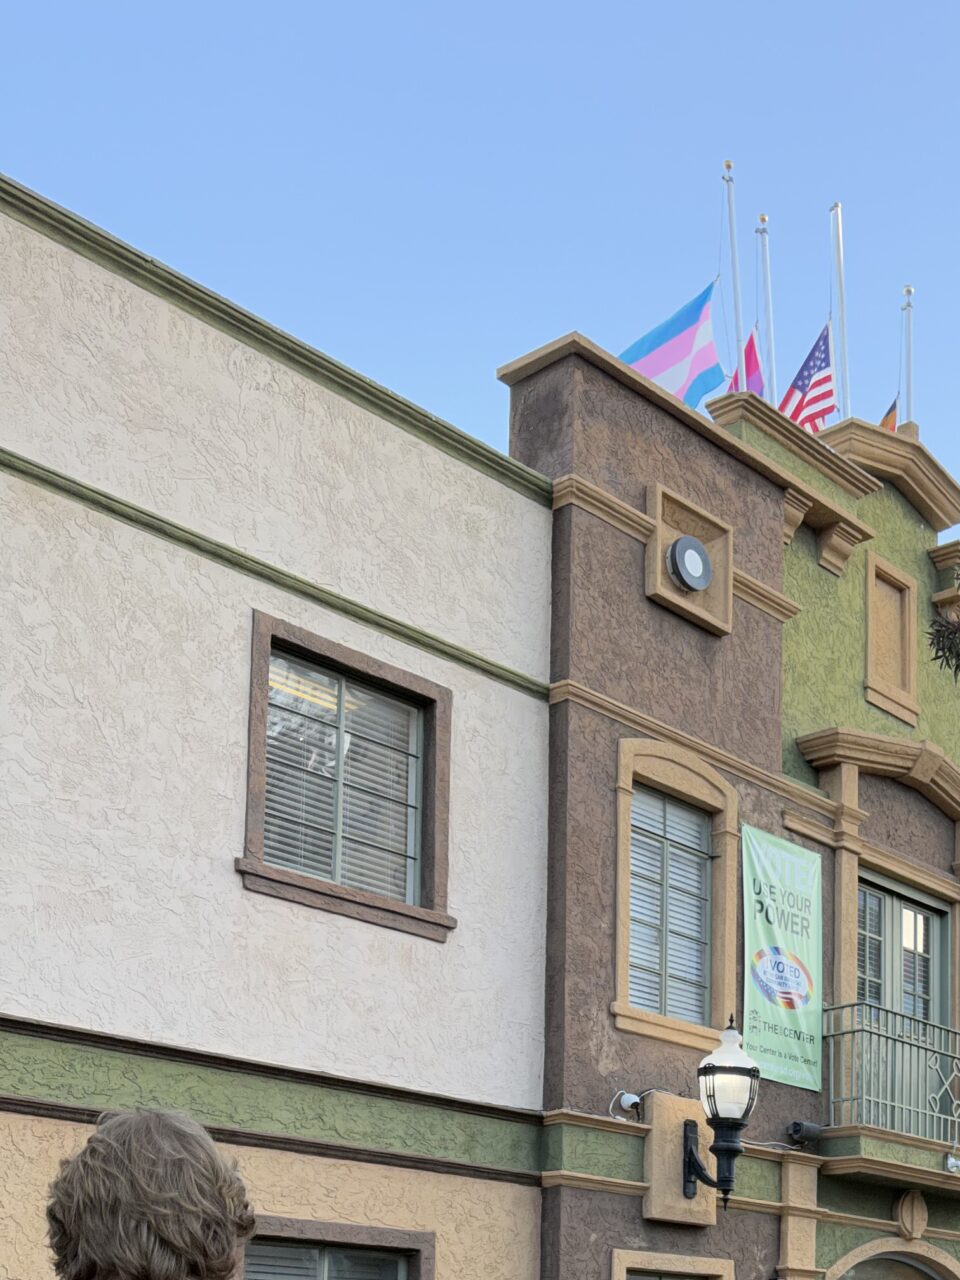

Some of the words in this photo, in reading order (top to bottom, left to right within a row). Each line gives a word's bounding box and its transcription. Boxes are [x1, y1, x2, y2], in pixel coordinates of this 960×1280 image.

[753, 878, 776, 902] USE
[780, 888, 811, 915] YOUR
[753, 900, 810, 939] POWER
[770, 959, 800, 979] VOTED
[763, 1021, 779, 1035] THE
[783, 1027, 815, 1045] CENTER
[759, 1045, 776, 1056] Center
